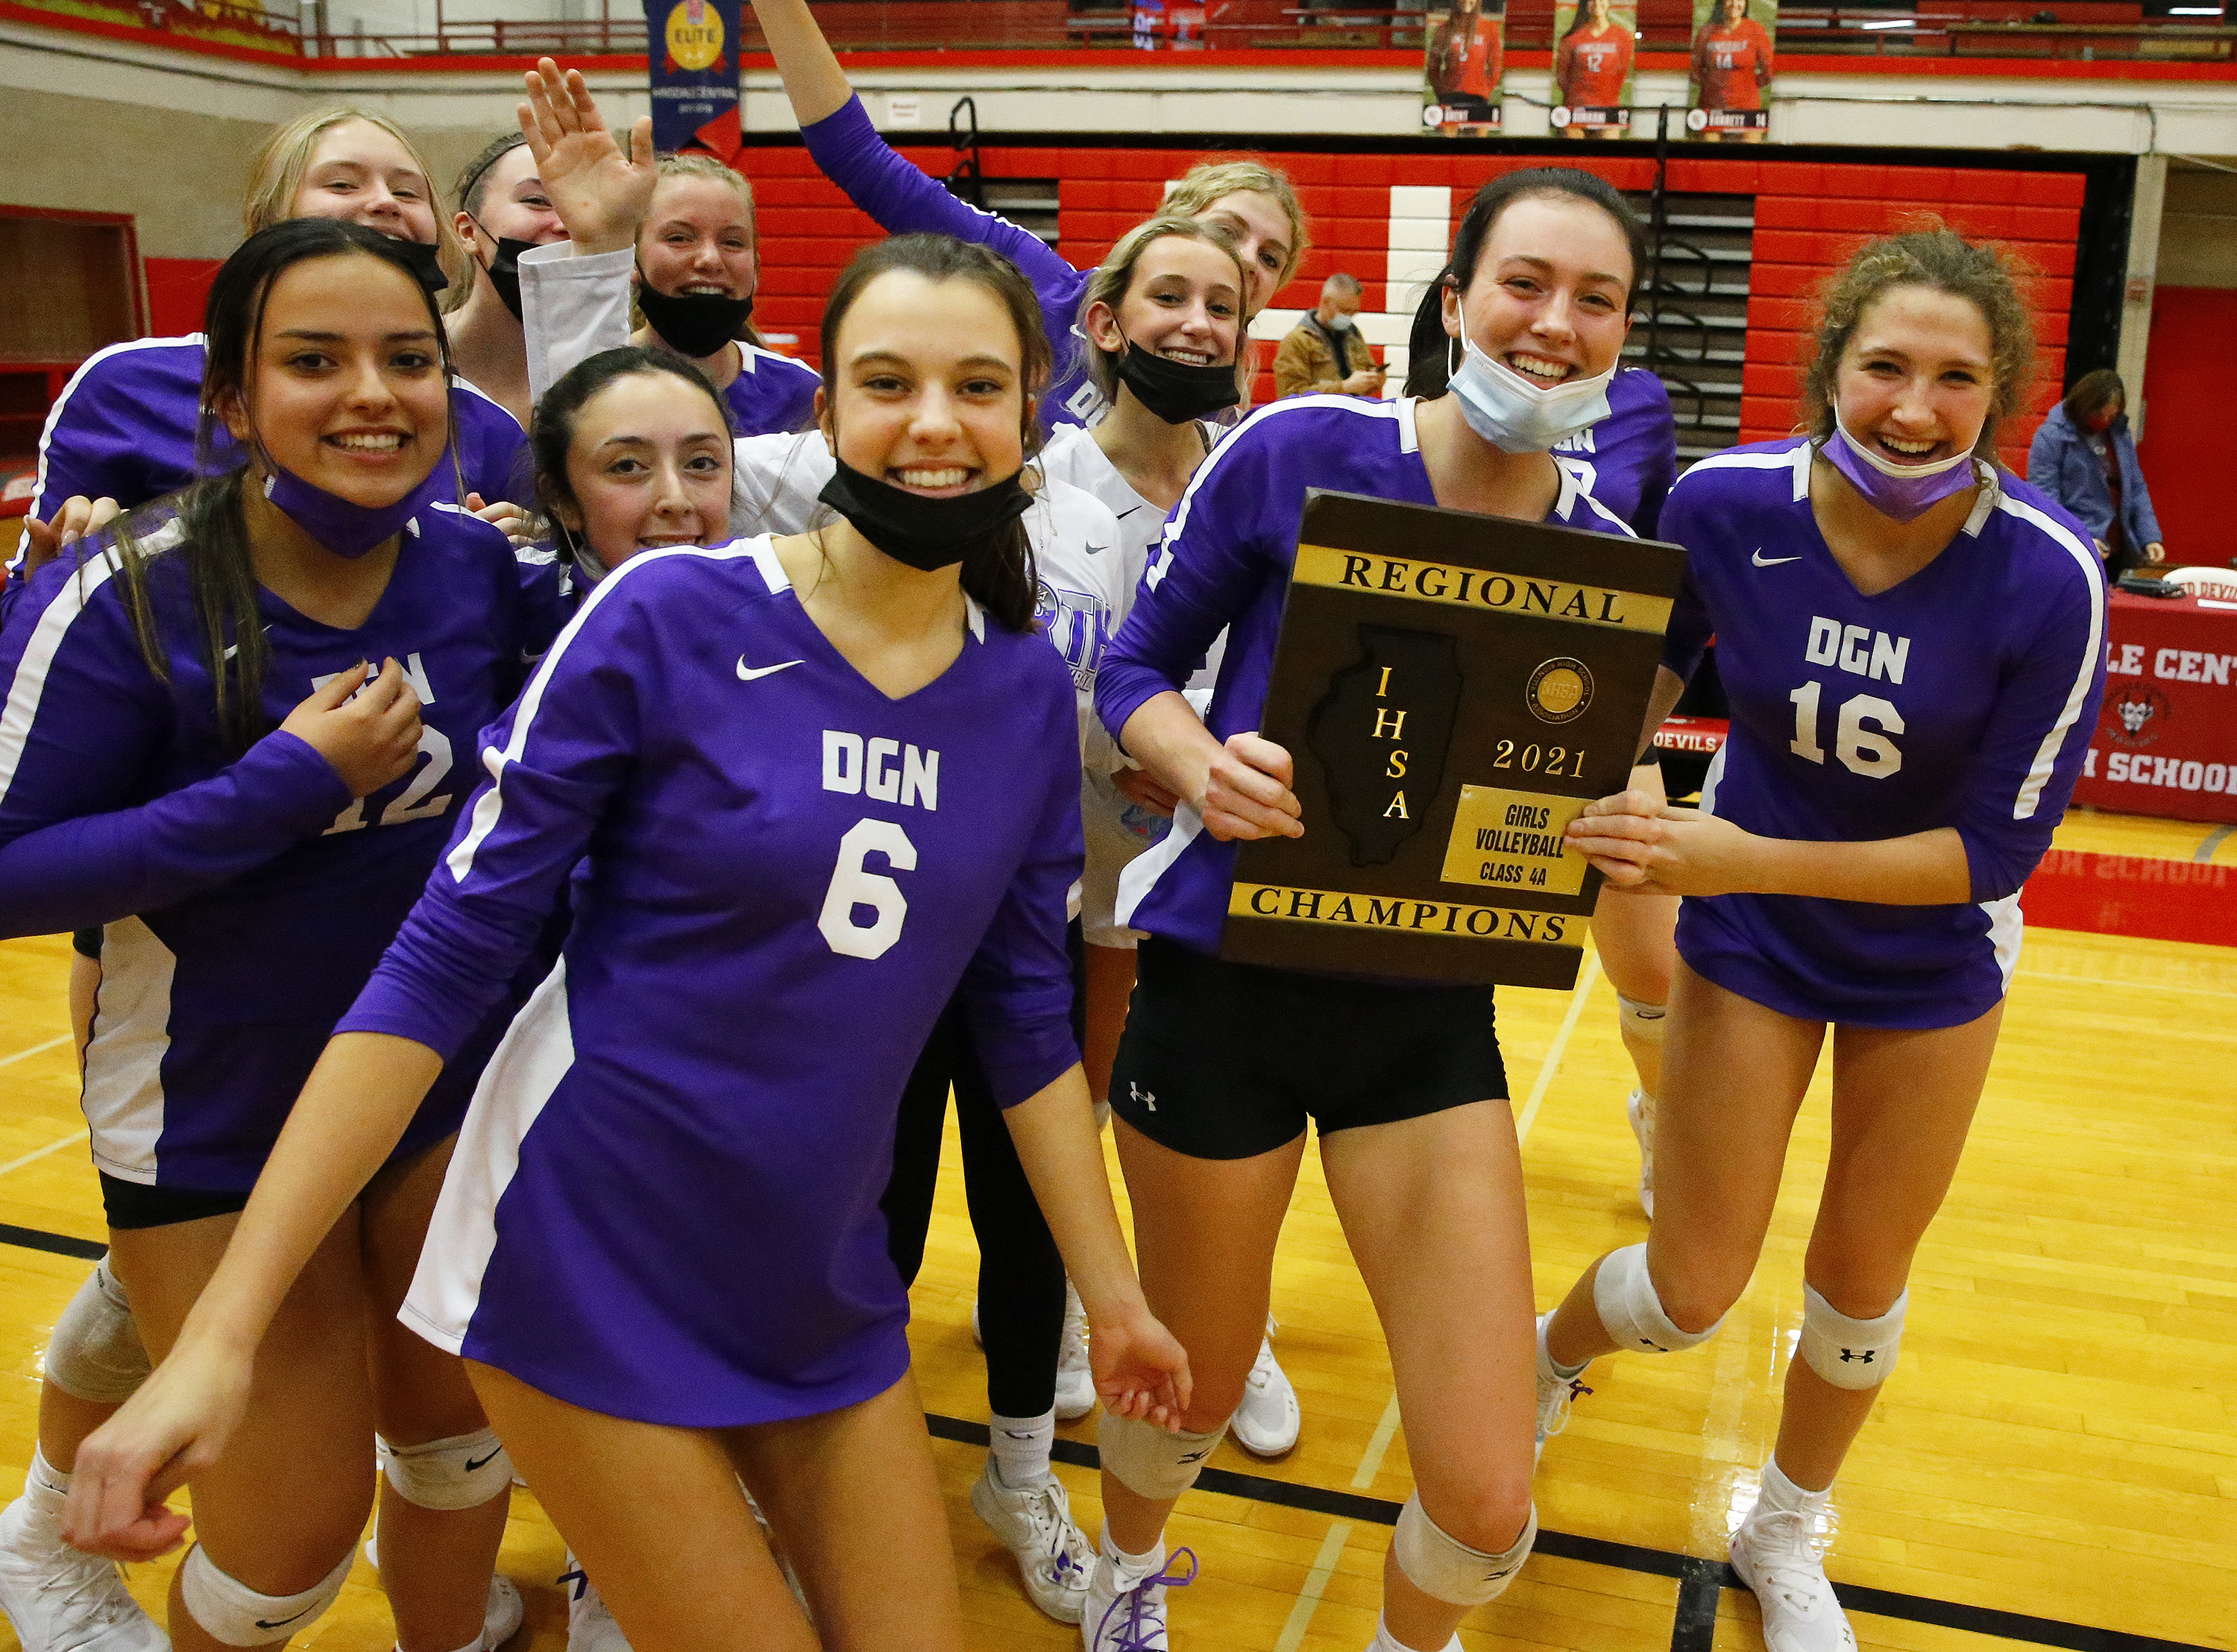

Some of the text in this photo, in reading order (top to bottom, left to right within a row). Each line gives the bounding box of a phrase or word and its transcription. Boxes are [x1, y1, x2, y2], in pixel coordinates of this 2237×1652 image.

[674, 27, 716, 43] ELITE
[1338, 554, 1625, 624] REGIONAL
[1805, 615, 1911, 685] DGN
[2153, 647, 2237, 687] CEN
[1557, 661, 1576, 669] HIGH
[1578, 668, 1591, 697] SCHOOL
[1532, 702, 1579, 721] ASSOCIATION
[1790, 680, 1905, 780] 16
[1493, 739, 1585, 778] 2021
[1652, 731, 1717, 753] DEVILS
[822, 729, 940, 812] DGN
[1504, 804, 1550, 830] GIRLS
[1476, 827, 1565, 859] VOLLEYBALL
[817, 817, 918, 961] 6
[1479, 862, 1547, 886] CLASS 4A
[1250, 887, 1566, 942] CHAMPIONS
